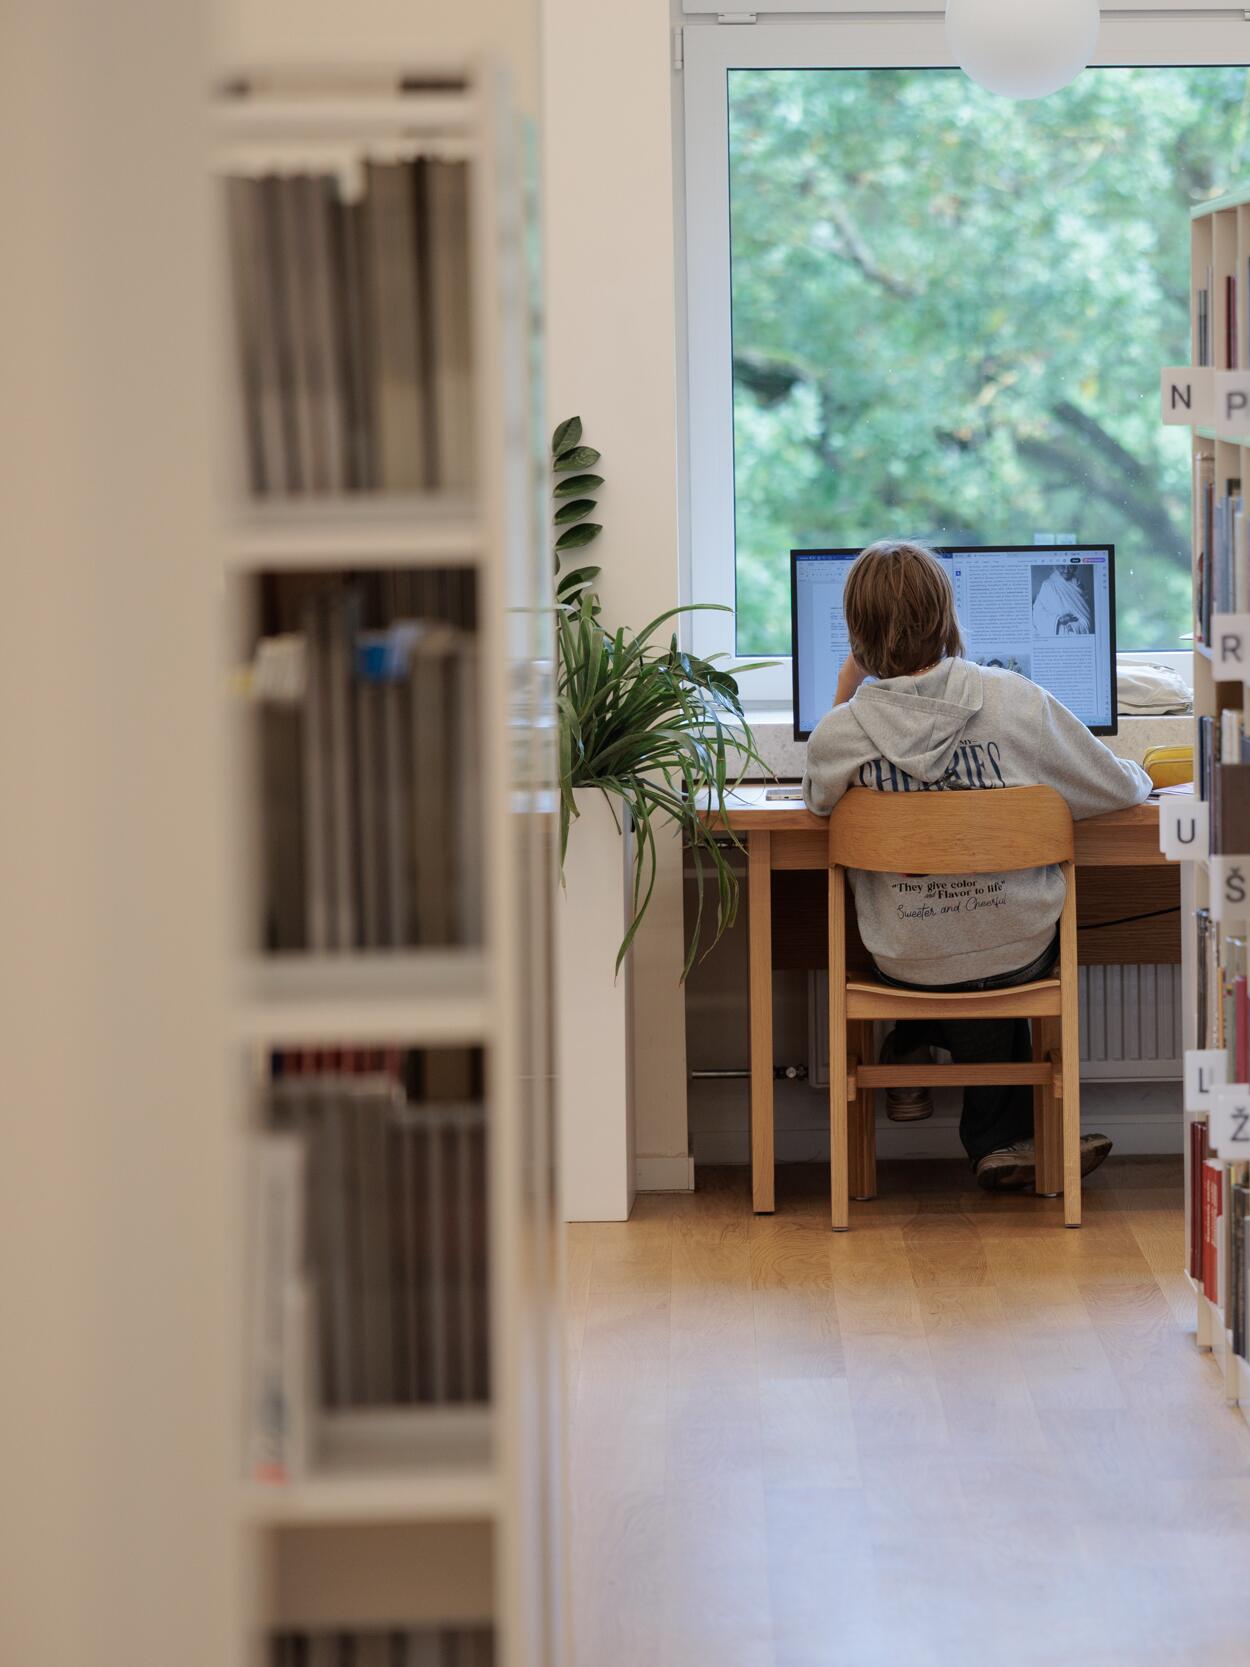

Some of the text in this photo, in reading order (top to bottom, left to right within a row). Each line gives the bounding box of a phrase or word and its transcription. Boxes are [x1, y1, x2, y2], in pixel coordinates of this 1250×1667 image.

[1170, 383, 1192, 410] N
[1225, 392, 1248, 419] P
[1220, 634, 1243, 662] R
[1176, 818, 1196, 844] U
[927, 881, 947, 893] give
[950, 880, 977, 889] color
[938, 889, 972, 899] Flavor
[1225, 866, 1246, 904] Š
[897, 893, 1006, 920] Sweeter and Cheerful
[1230, 1105, 1250, 1142] Ž
